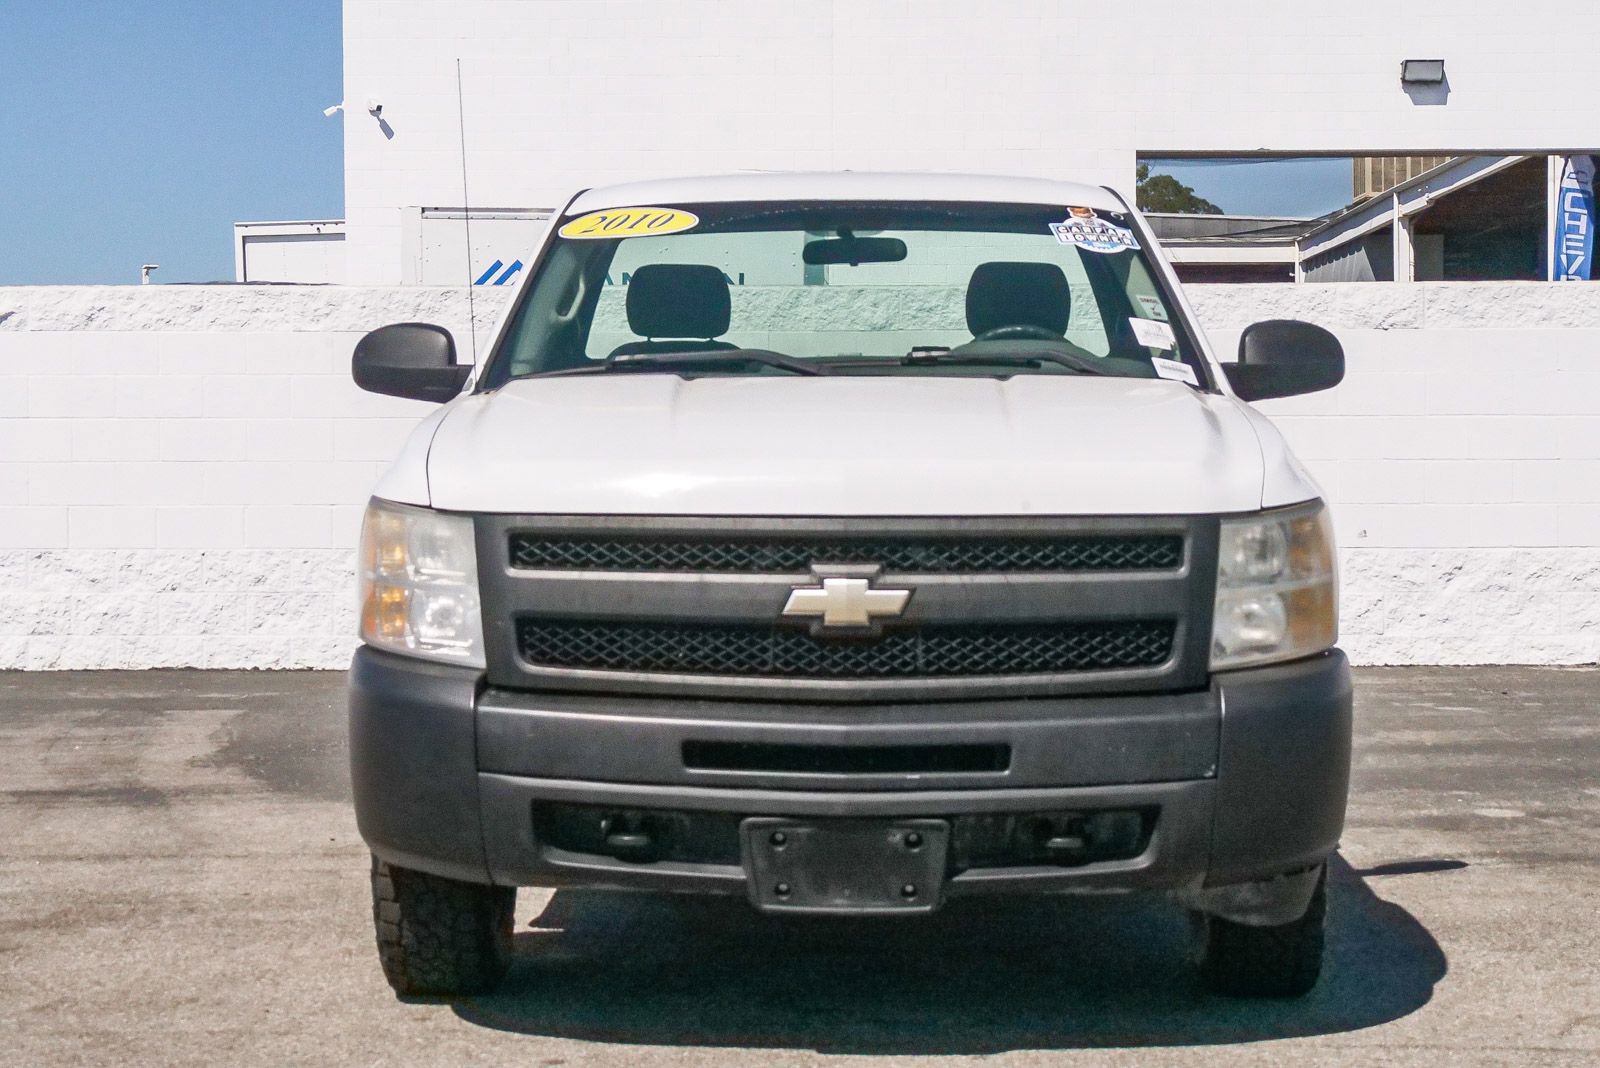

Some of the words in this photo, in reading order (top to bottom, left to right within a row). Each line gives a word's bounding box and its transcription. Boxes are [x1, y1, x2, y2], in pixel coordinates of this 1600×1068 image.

[579, 213, 675, 233] 2010
[1074, 234, 1132, 246] OWNER
[1560, 192, 1588, 281] CHEV
